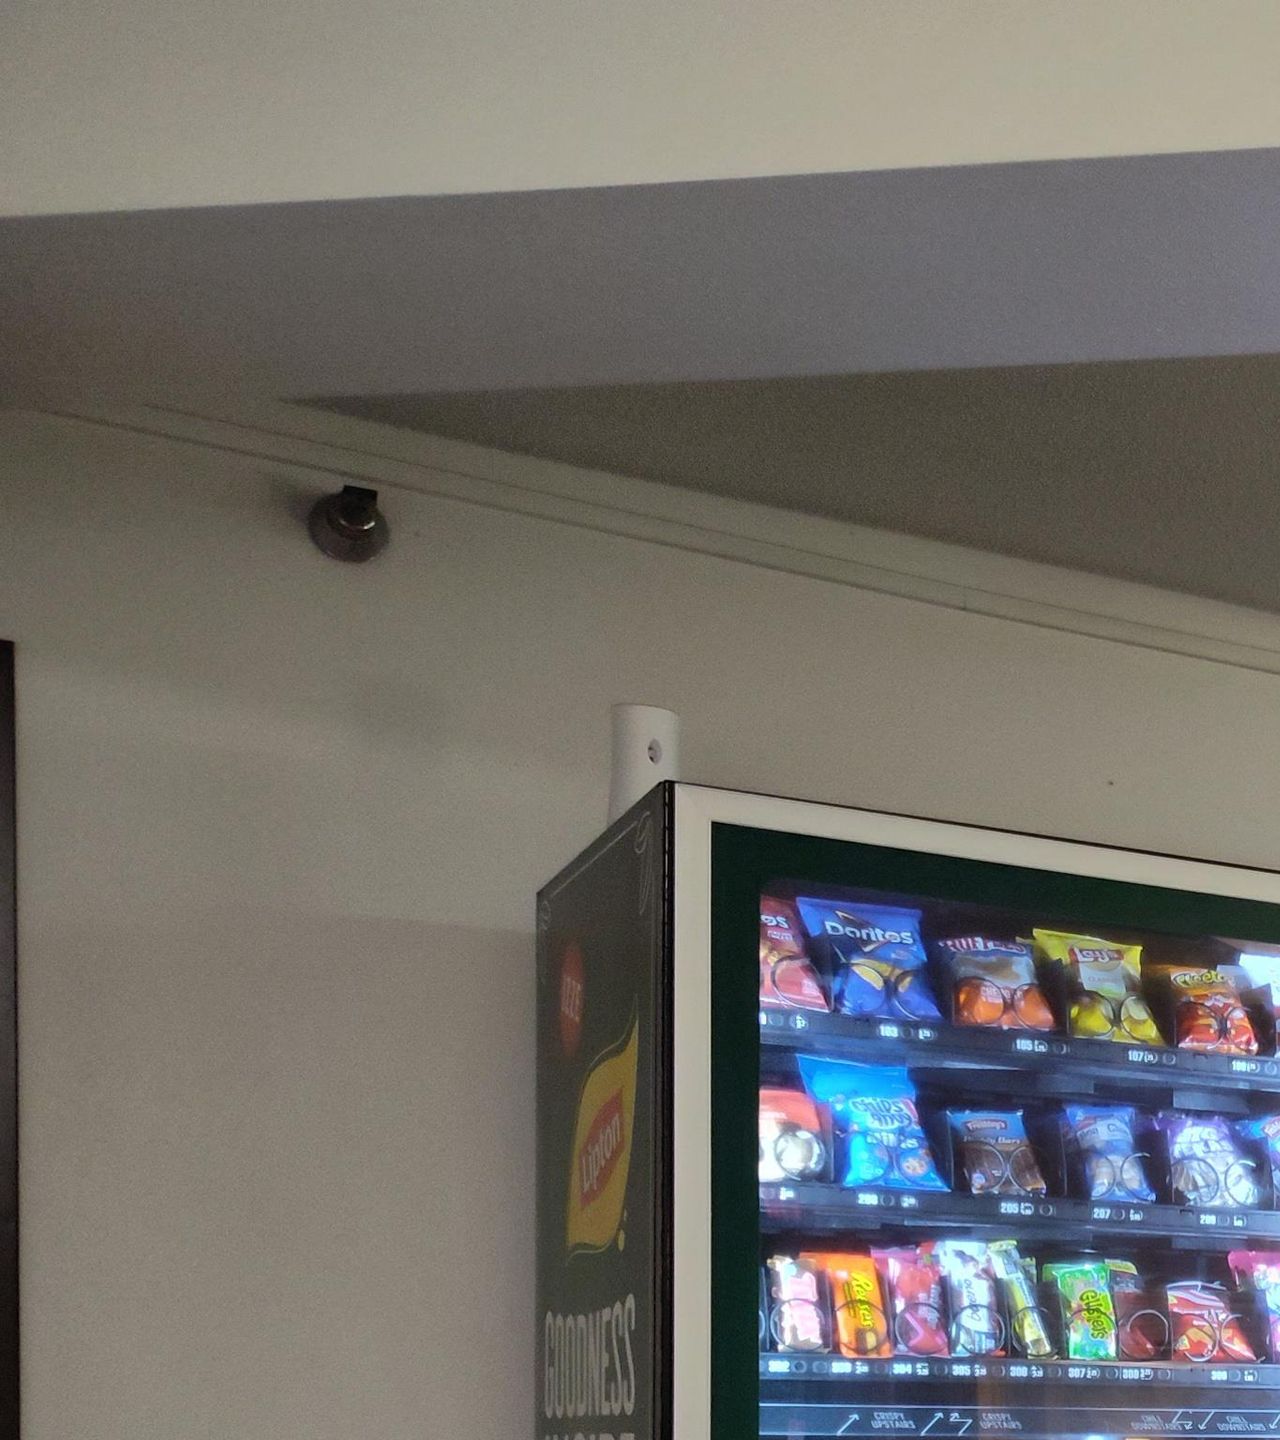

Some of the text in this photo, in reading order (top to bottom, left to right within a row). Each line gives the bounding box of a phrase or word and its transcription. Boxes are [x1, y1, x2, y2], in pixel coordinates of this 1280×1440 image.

[824, 919, 915, 945] Doritos
[1075, 948, 1121, 962] Lay's
[1127, 1050, 1144, 1062] 107
[581, 1113, 621, 1193] Lipton
[1093, 1209, 1111, 1220] 207
[544, 1293, 637, 1419] GOODNESS
